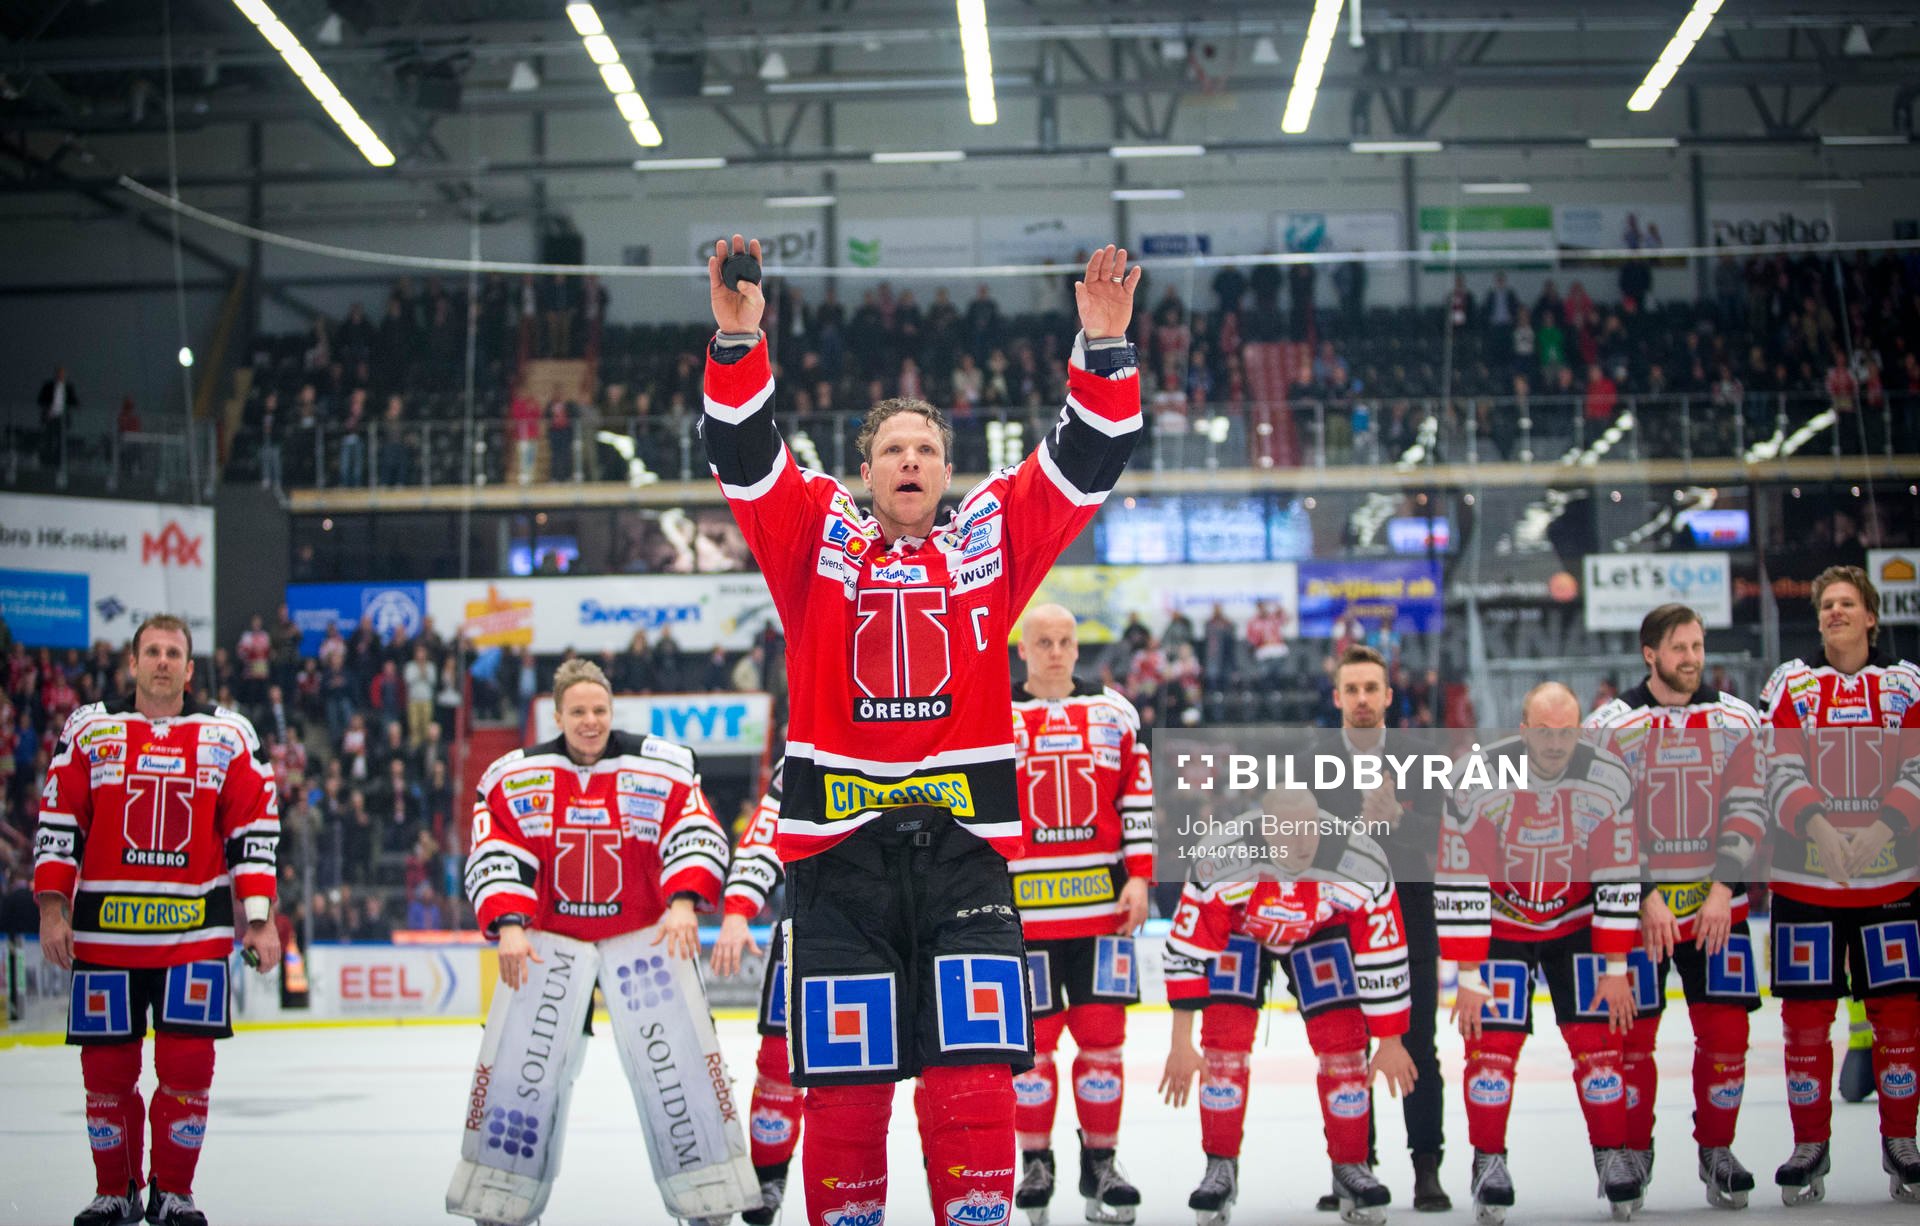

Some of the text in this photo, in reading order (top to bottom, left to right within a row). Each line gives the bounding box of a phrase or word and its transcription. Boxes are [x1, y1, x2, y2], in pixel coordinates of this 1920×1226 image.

[142, 520, 203, 567] MAX
[1592, 562, 1665, 589] Let's
[580, 600, 701, 628] Swegon
[970, 606, 989, 652] C
[859, 699, 946, 719] ÖREBRO
[43, 774, 58, 808] 4
[831, 780, 968, 812] CITY GROSS
[1824, 797, 1879, 811] ÖREBRO
[1035, 827, 1094, 842] ÖREBRO
[1654, 839, 1708, 854] ÖREBRO
[126, 849, 186, 866] ÖREBRO
[1020, 873, 1111, 900] CITY GROSS
[103, 901, 200, 925] CITY GROSS
[558, 900, 618, 916] ÖREBRO
[1368, 910, 1400, 949] 23
[340, 965, 422, 999] EEL
[517, 950, 576, 1101] SOLIDUM
[466, 1064, 493, 1132] Reebok
[641, 1022, 702, 1169] SOLIDUM
[704, 1051, 737, 1123] Reebok
[962, 1167, 1013, 1178] EASTON
[953, 1203, 1006, 1221] MOAB
